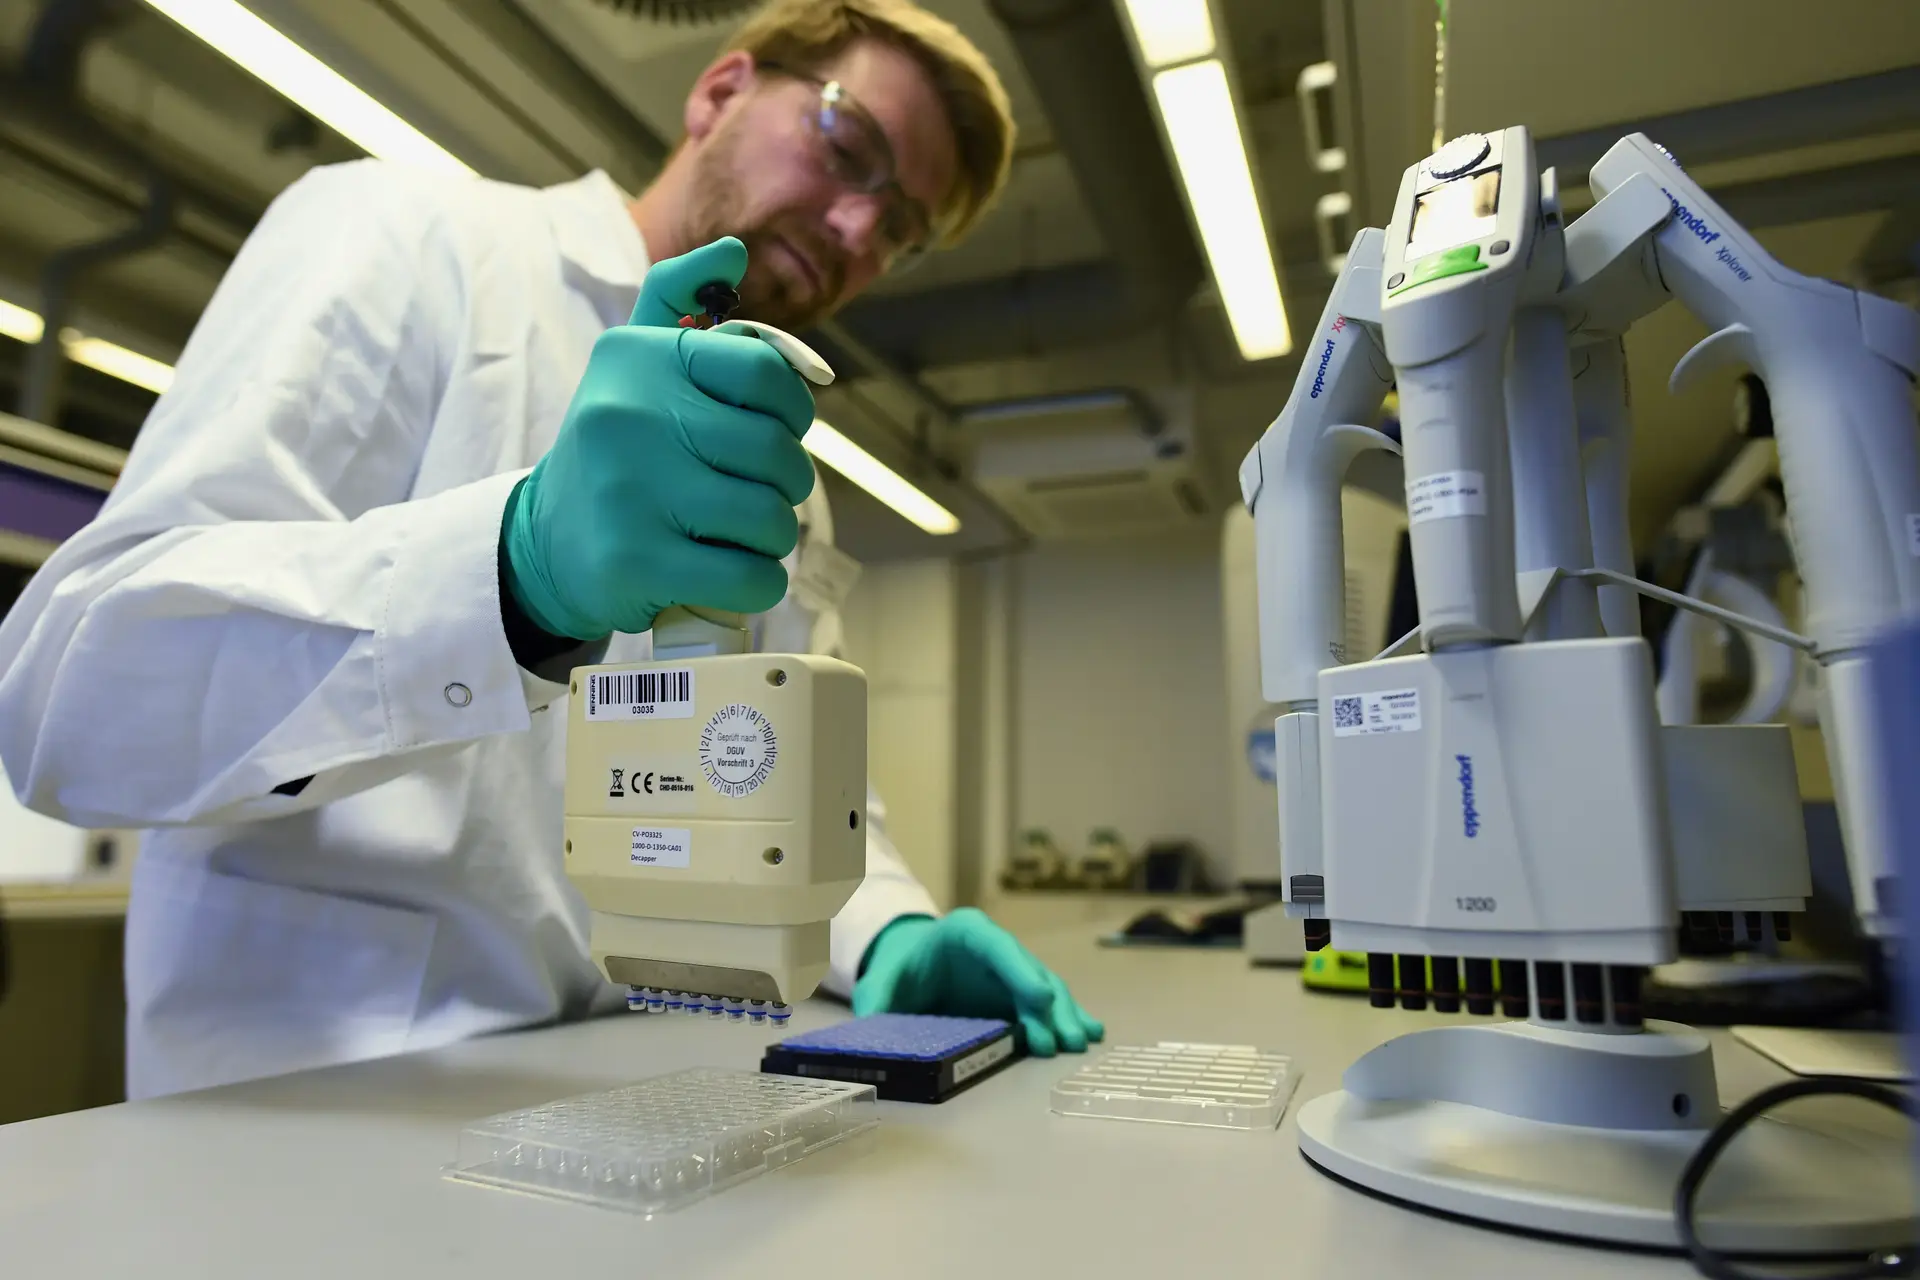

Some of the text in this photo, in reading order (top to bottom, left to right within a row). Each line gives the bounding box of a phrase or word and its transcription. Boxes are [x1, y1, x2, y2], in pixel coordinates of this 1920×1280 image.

[1716, 246, 1752, 282] Xplorer
[1311, 339, 1335, 398] eppendorf
[632, 705, 654, 714] 03035
[720, 710, 726, 719] 5
[730, 706, 736, 715] 6
[741, 706, 747, 715] 7
[749, 711, 757, 720] 8
[717, 733, 757, 742] Geprüft nach
[726, 746, 746, 755] DGUV
[717, 758, 754, 767] Vorschrift 3
[1455, 755, 1480, 837] eppendorf
[1456, 897, 1496, 912] 1200
